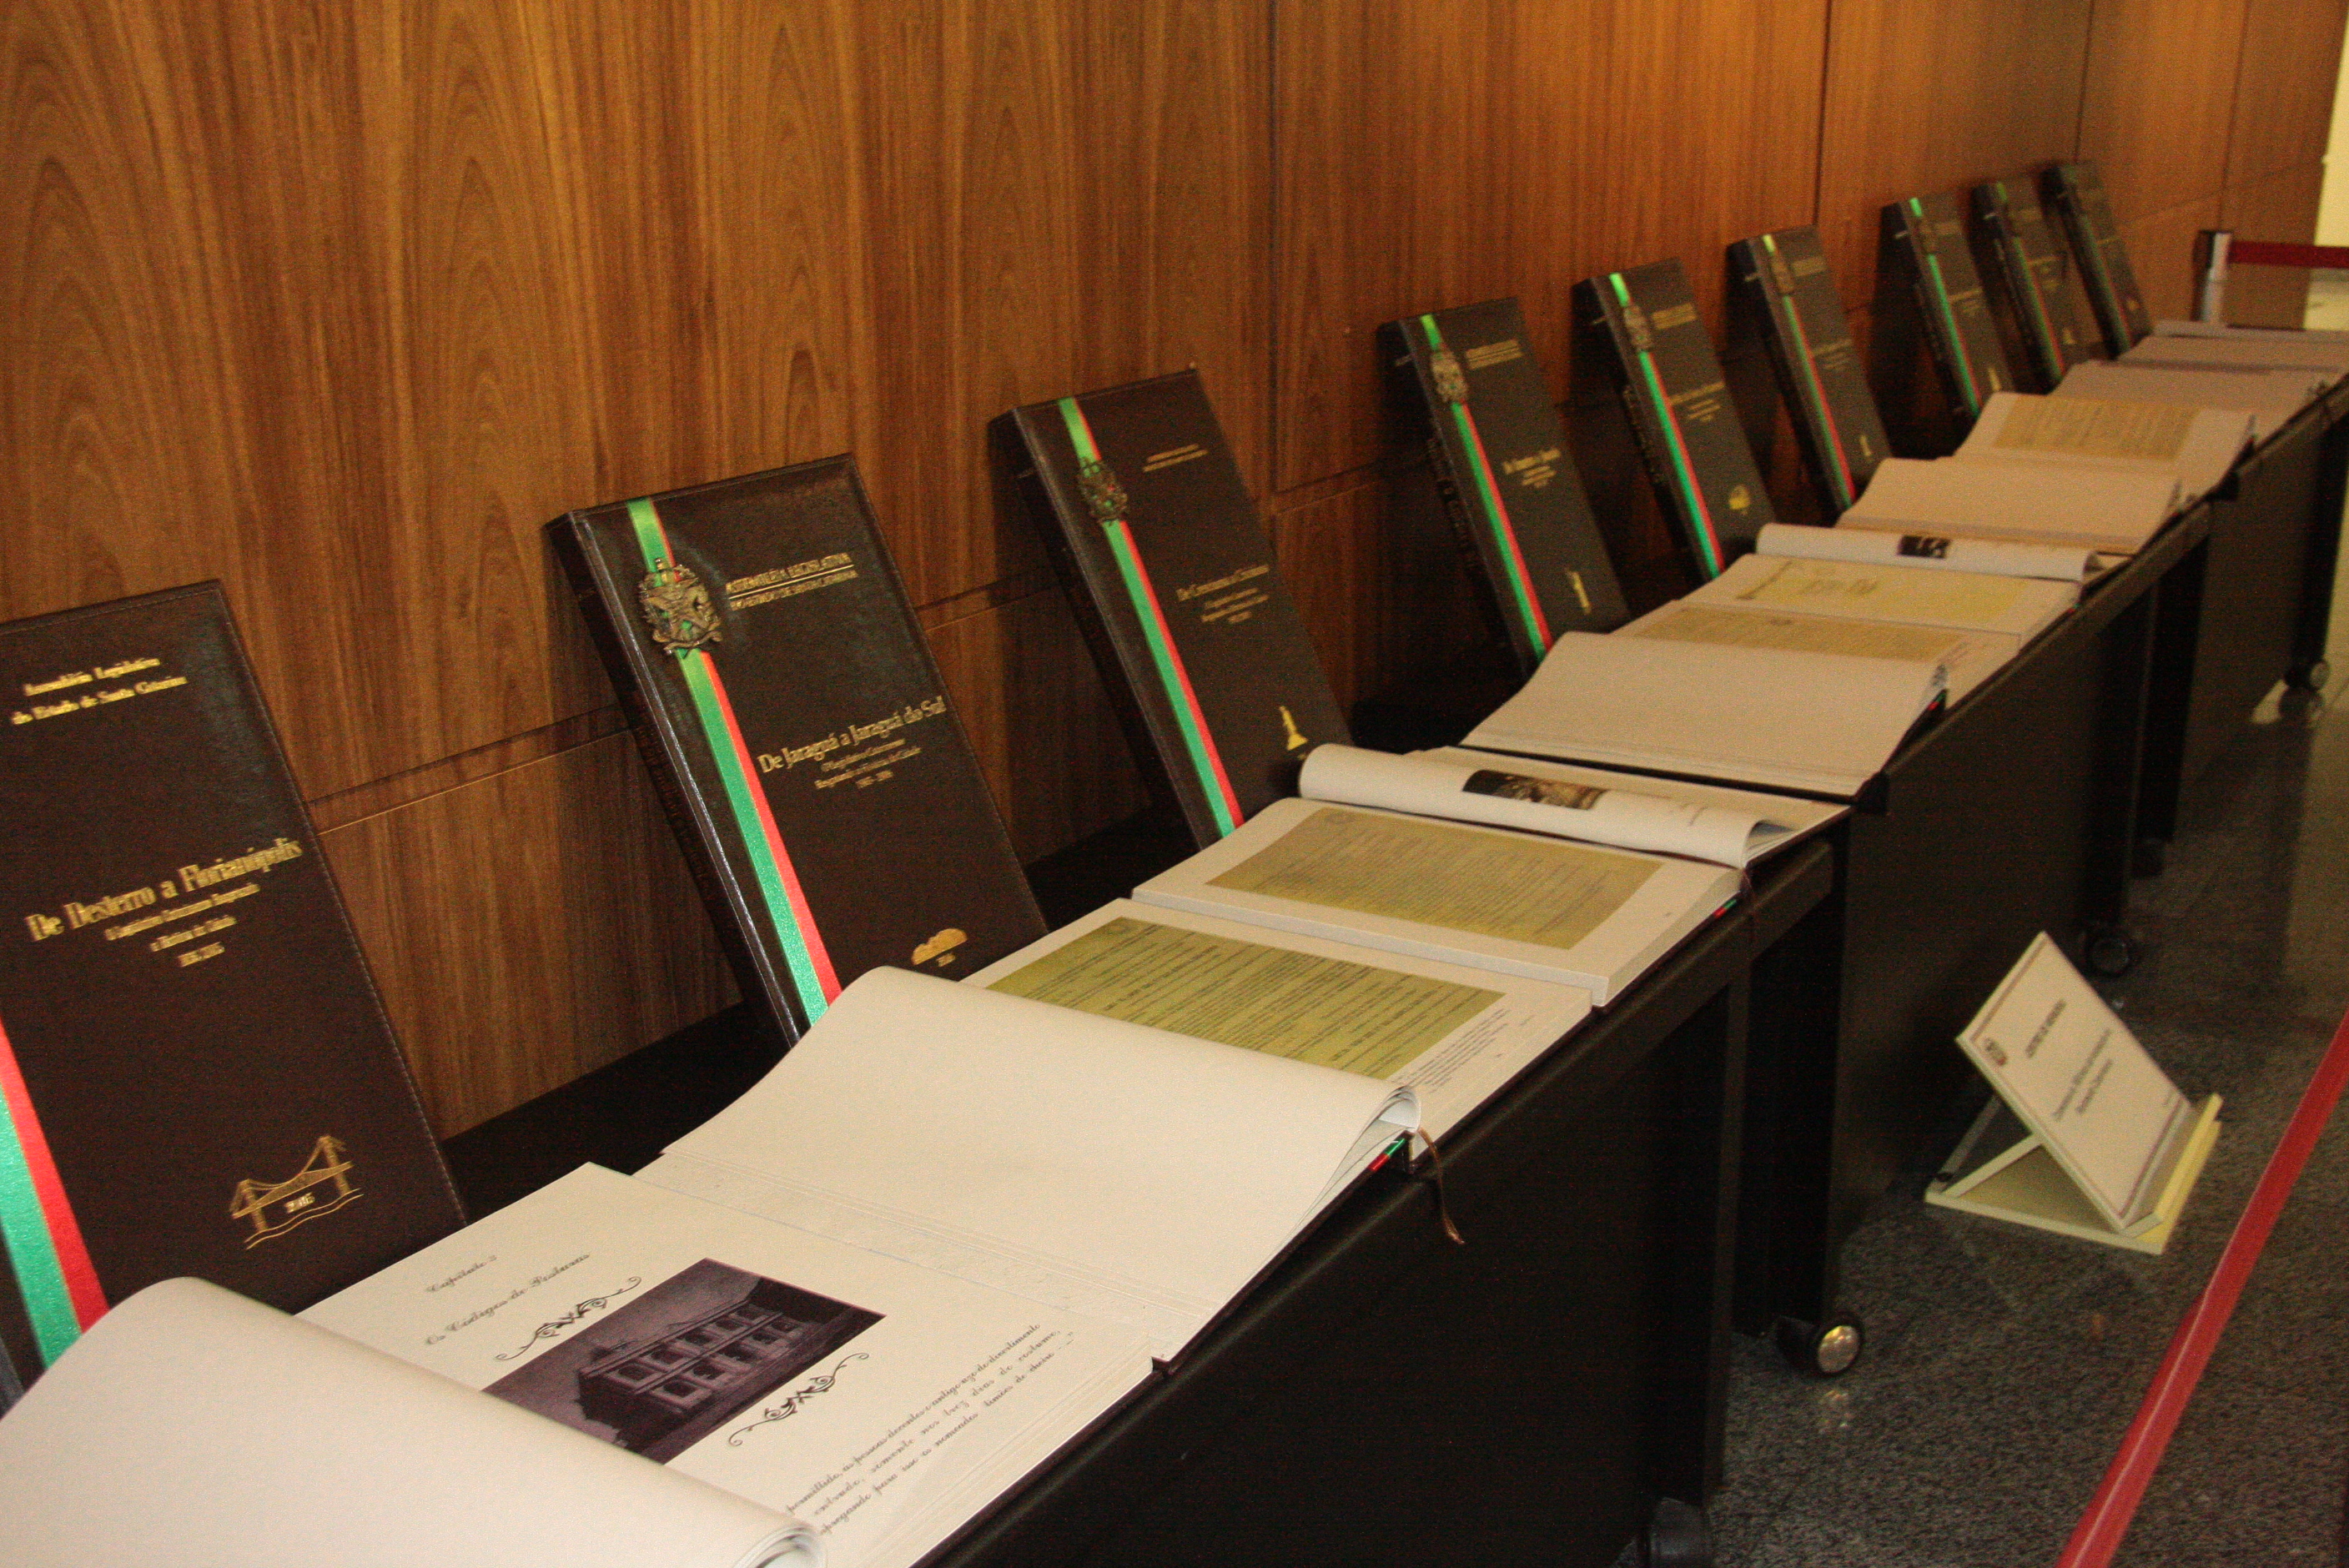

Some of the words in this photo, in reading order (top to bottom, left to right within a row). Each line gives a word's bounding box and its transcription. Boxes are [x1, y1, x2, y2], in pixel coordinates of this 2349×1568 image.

[757, 753, 785, 773] De
[781, 732, 841, 770] Jaraguá
[839, 732, 852, 746] a
[848, 711, 904, 746] Jaraguá
[903, 706, 924, 724] do
[920, 695, 947, 718] Sul
[24, 913, 64, 942] De
[63, 896, 157, 929] Desterro
[160, 881, 179, 899] a
